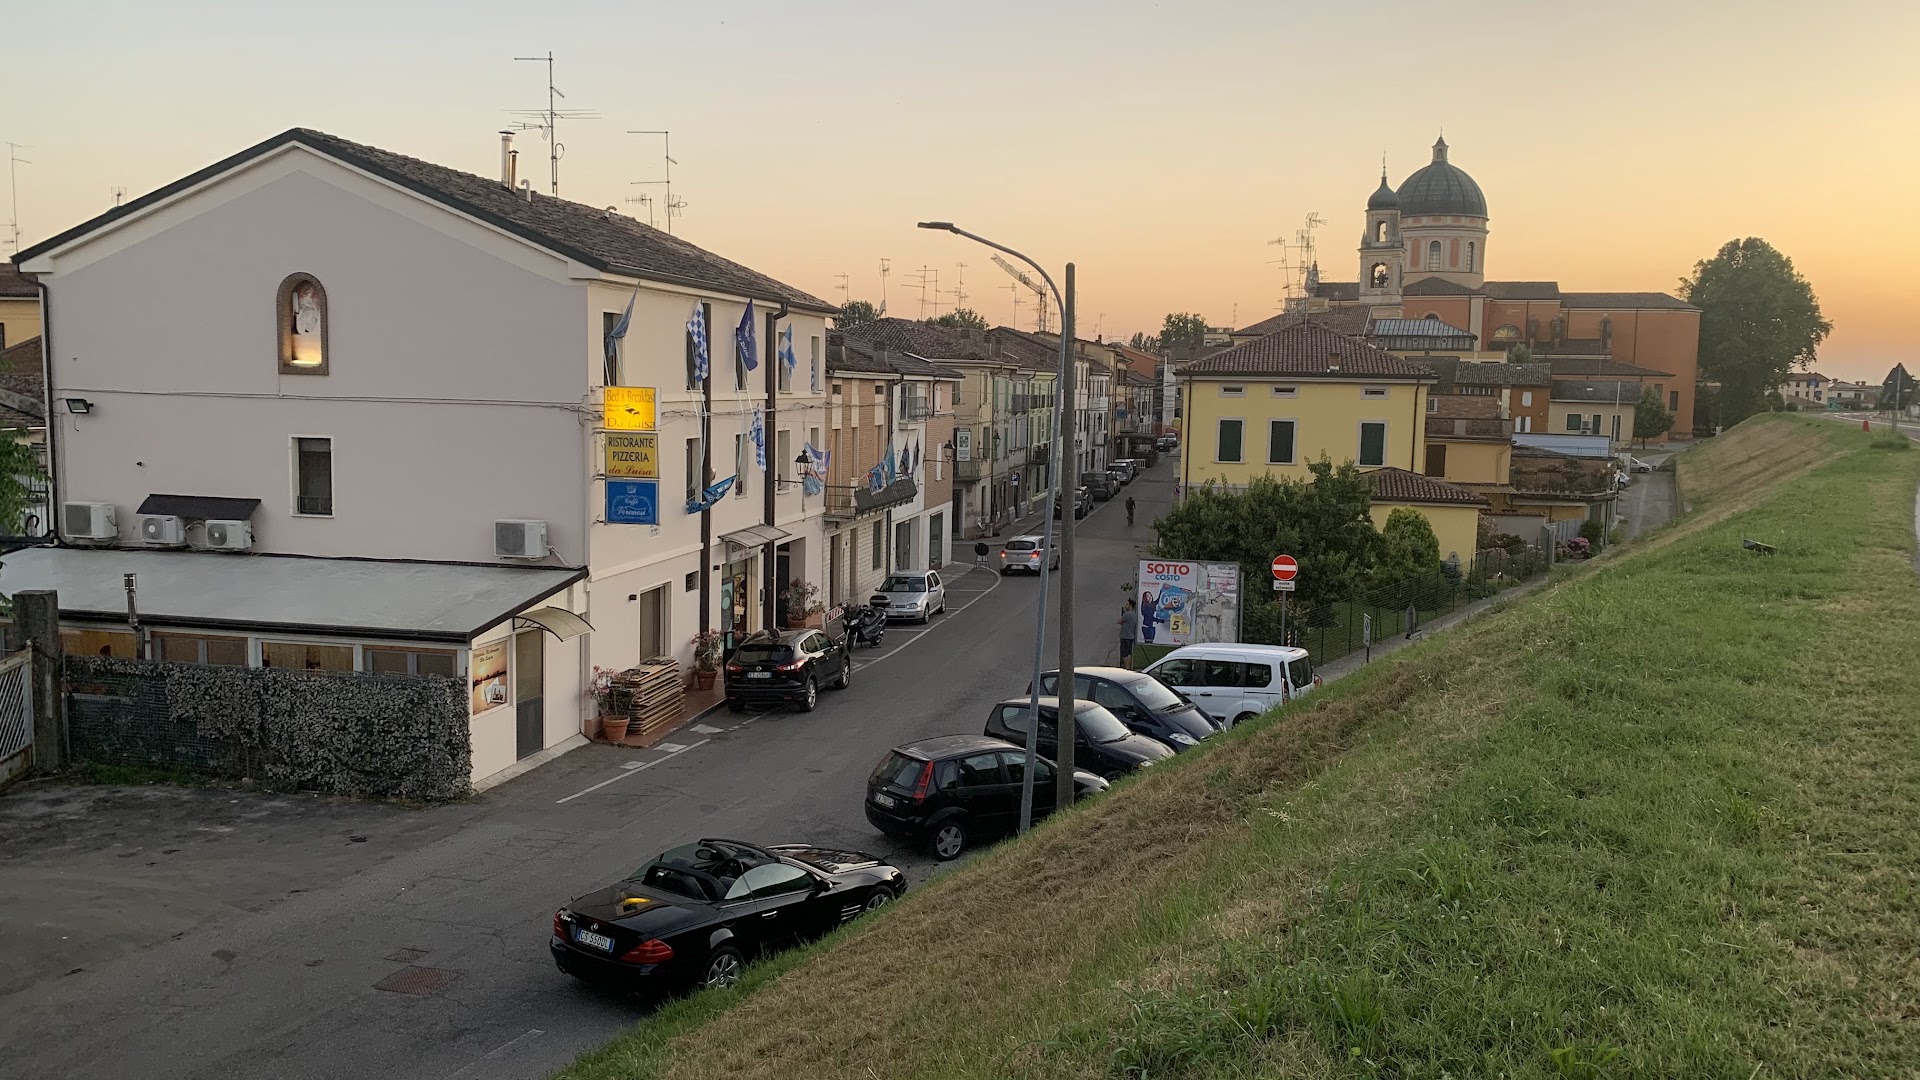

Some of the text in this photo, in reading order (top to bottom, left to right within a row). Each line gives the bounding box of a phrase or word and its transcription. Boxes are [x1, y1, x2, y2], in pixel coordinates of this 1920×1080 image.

[606, 389, 620, 402] Bed
[608, 436, 655, 449] RISTORANTE
[612, 450, 650, 463] PIZZERIA
[608, 464, 653, 476] da Luisa
[1146, 563, 1190, 576] SOTTO
[1171, 620, 1180, 631] 5
[580, 931, 589, 943] CS
